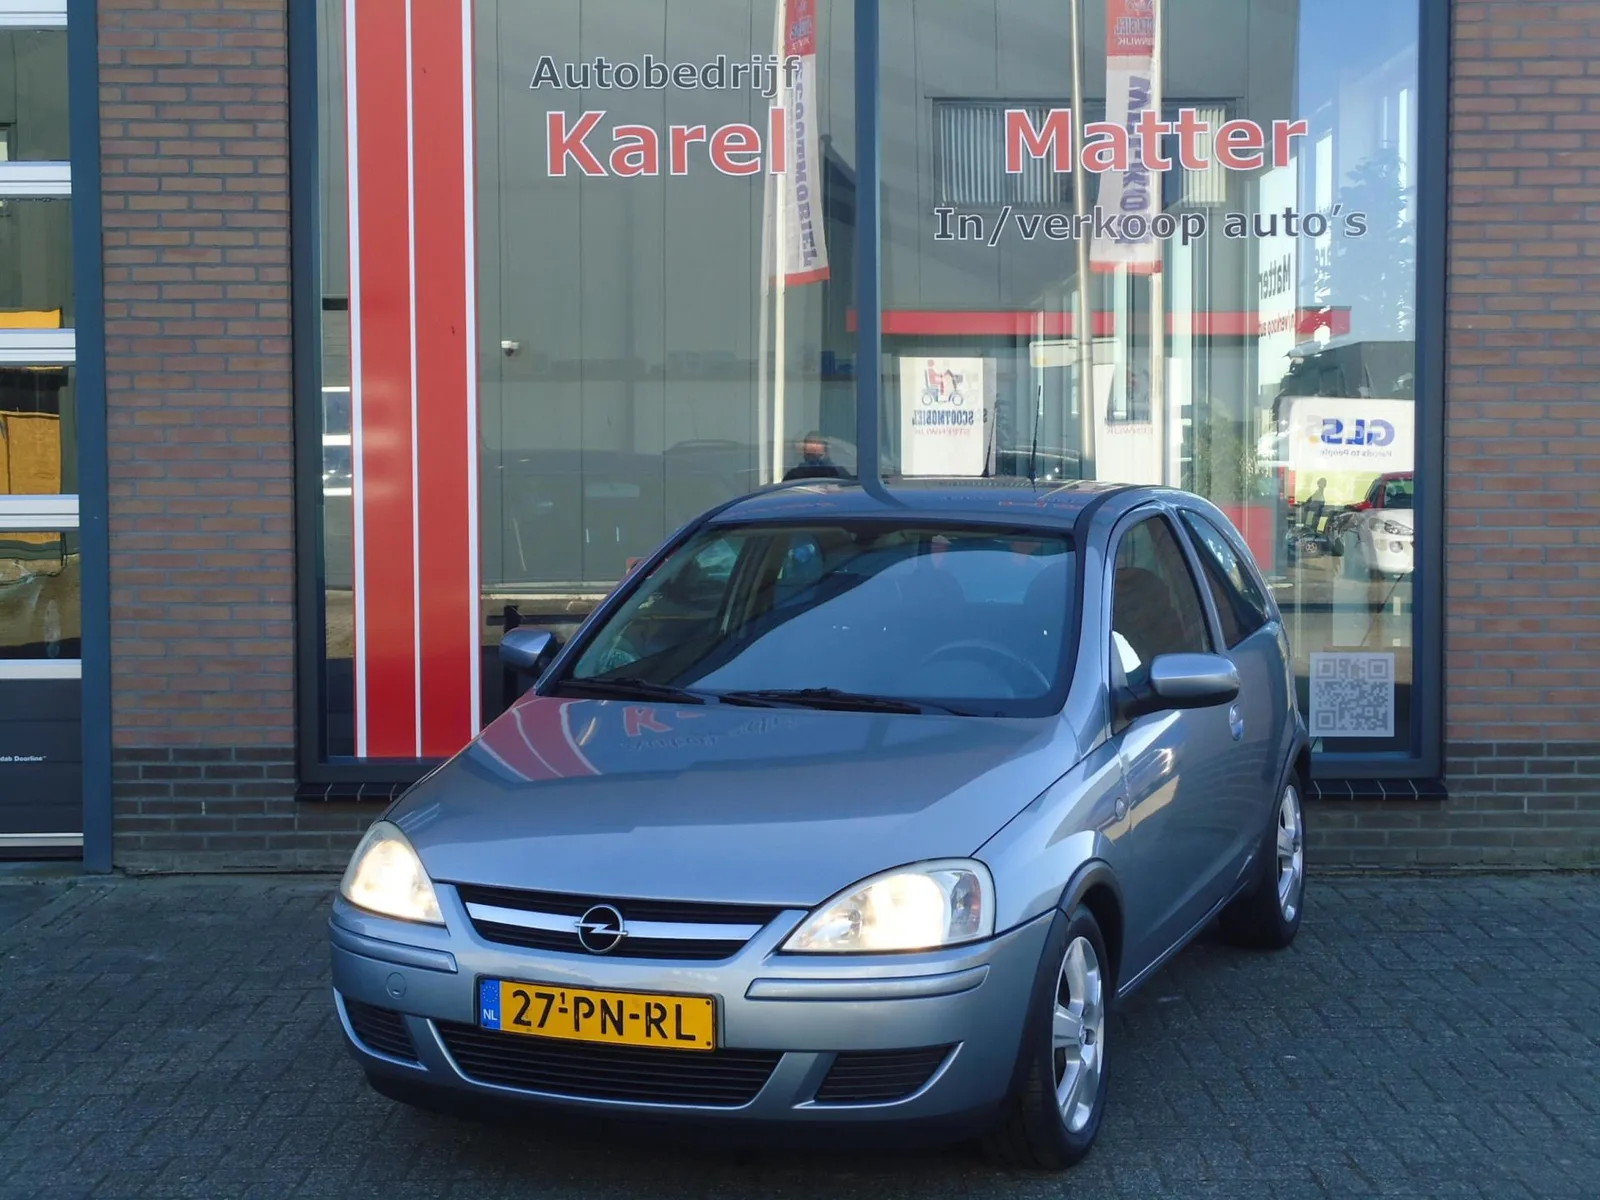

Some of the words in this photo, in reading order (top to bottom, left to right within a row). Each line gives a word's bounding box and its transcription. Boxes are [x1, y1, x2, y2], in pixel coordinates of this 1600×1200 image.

[530, 55, 801, 98] Autobedrijf
[546, 106, 787, 177] Karel
[1004, 107, 1308, 174] Matter
[934, 205, 1207, 246] In/verkoop
[1223, 203, 1368, 239] auto's
[483, 1008, 498, 1021] NL
